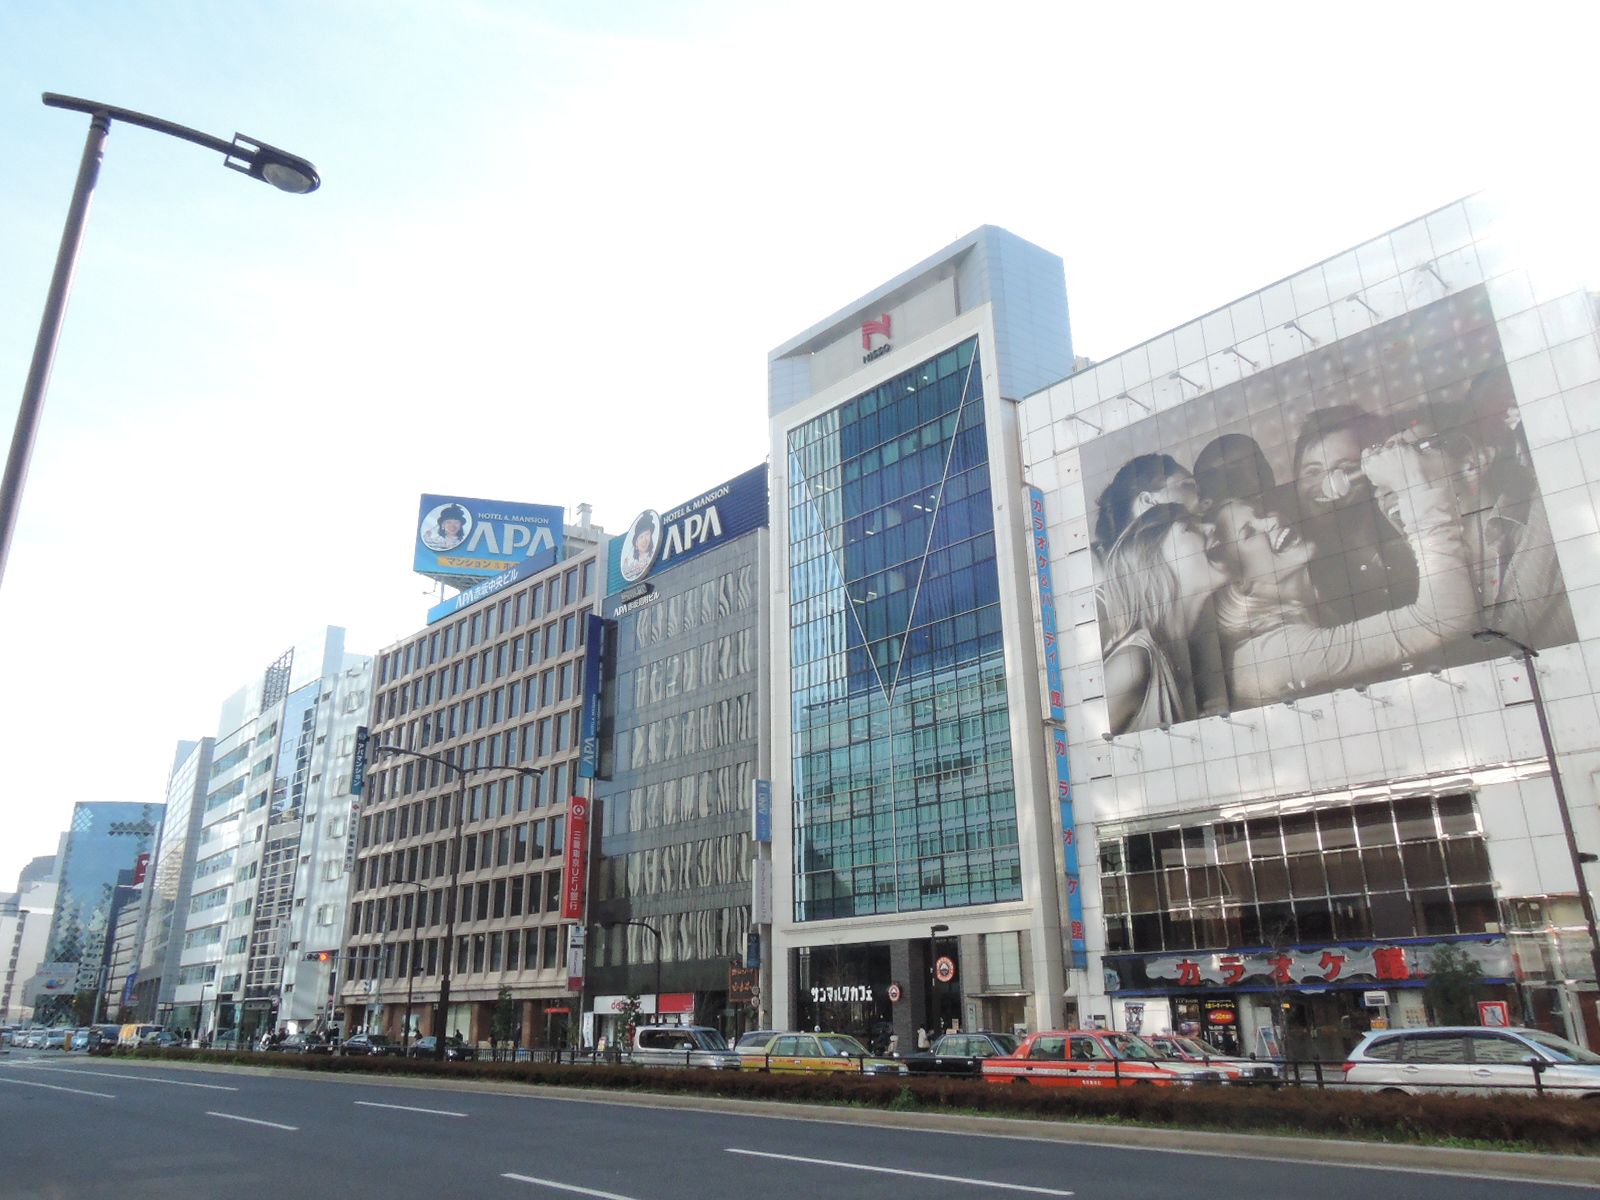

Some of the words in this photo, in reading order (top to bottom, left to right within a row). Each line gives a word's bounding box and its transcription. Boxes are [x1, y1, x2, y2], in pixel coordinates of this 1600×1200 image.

[512, 514, 549, 524] MANSION
[663, 509, 685, 525] HOTEL
[692, 486, 729, 510] MANSION
[466, 521, 556, 557] APA
[661, 505, 722, 560] APA
[582, 737, 595, 765] APA
[1176, 946, 1410, 986] カラオケ館
[810, 984, 873, 1003] サンマルクカフェ
